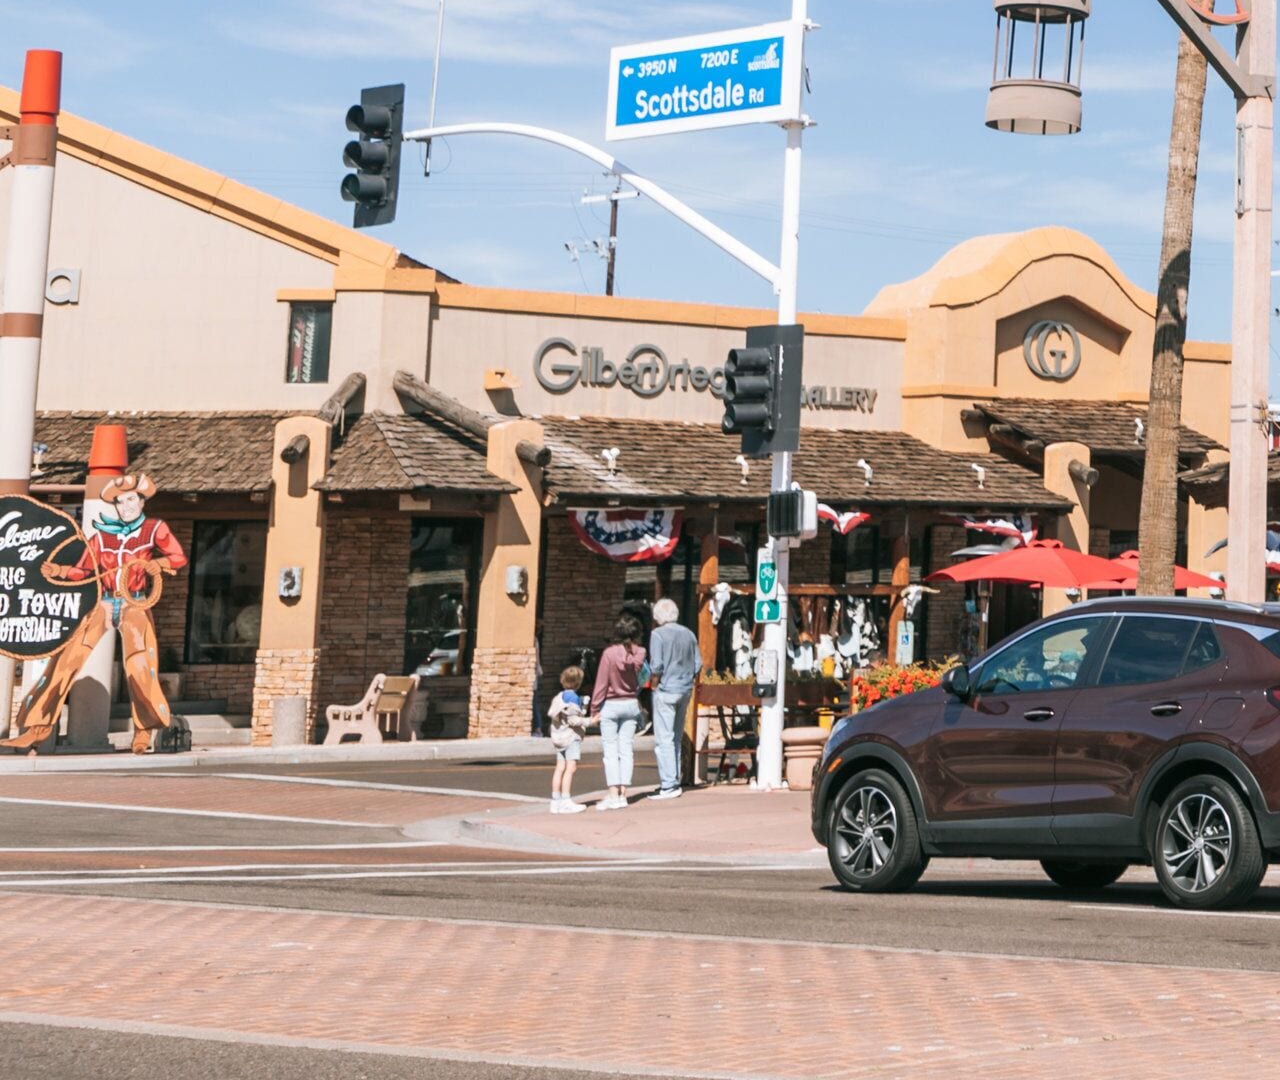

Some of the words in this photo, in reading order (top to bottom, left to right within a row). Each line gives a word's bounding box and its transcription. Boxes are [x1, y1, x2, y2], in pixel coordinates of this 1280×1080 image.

[638, 60, 666, 78] 3950
[668, 58, 677, 73] N
[701, 51, 729, 68] 7200
[730, 48, 739, 64] E
[635, 78, 744, 119] Scottsdale
[749, 88, 764, 104] Rd
[801, 386, 877, 412] ALLERY
[0, 511, 66, 551] elcome
[18, 589, 82, 619] TOWN
